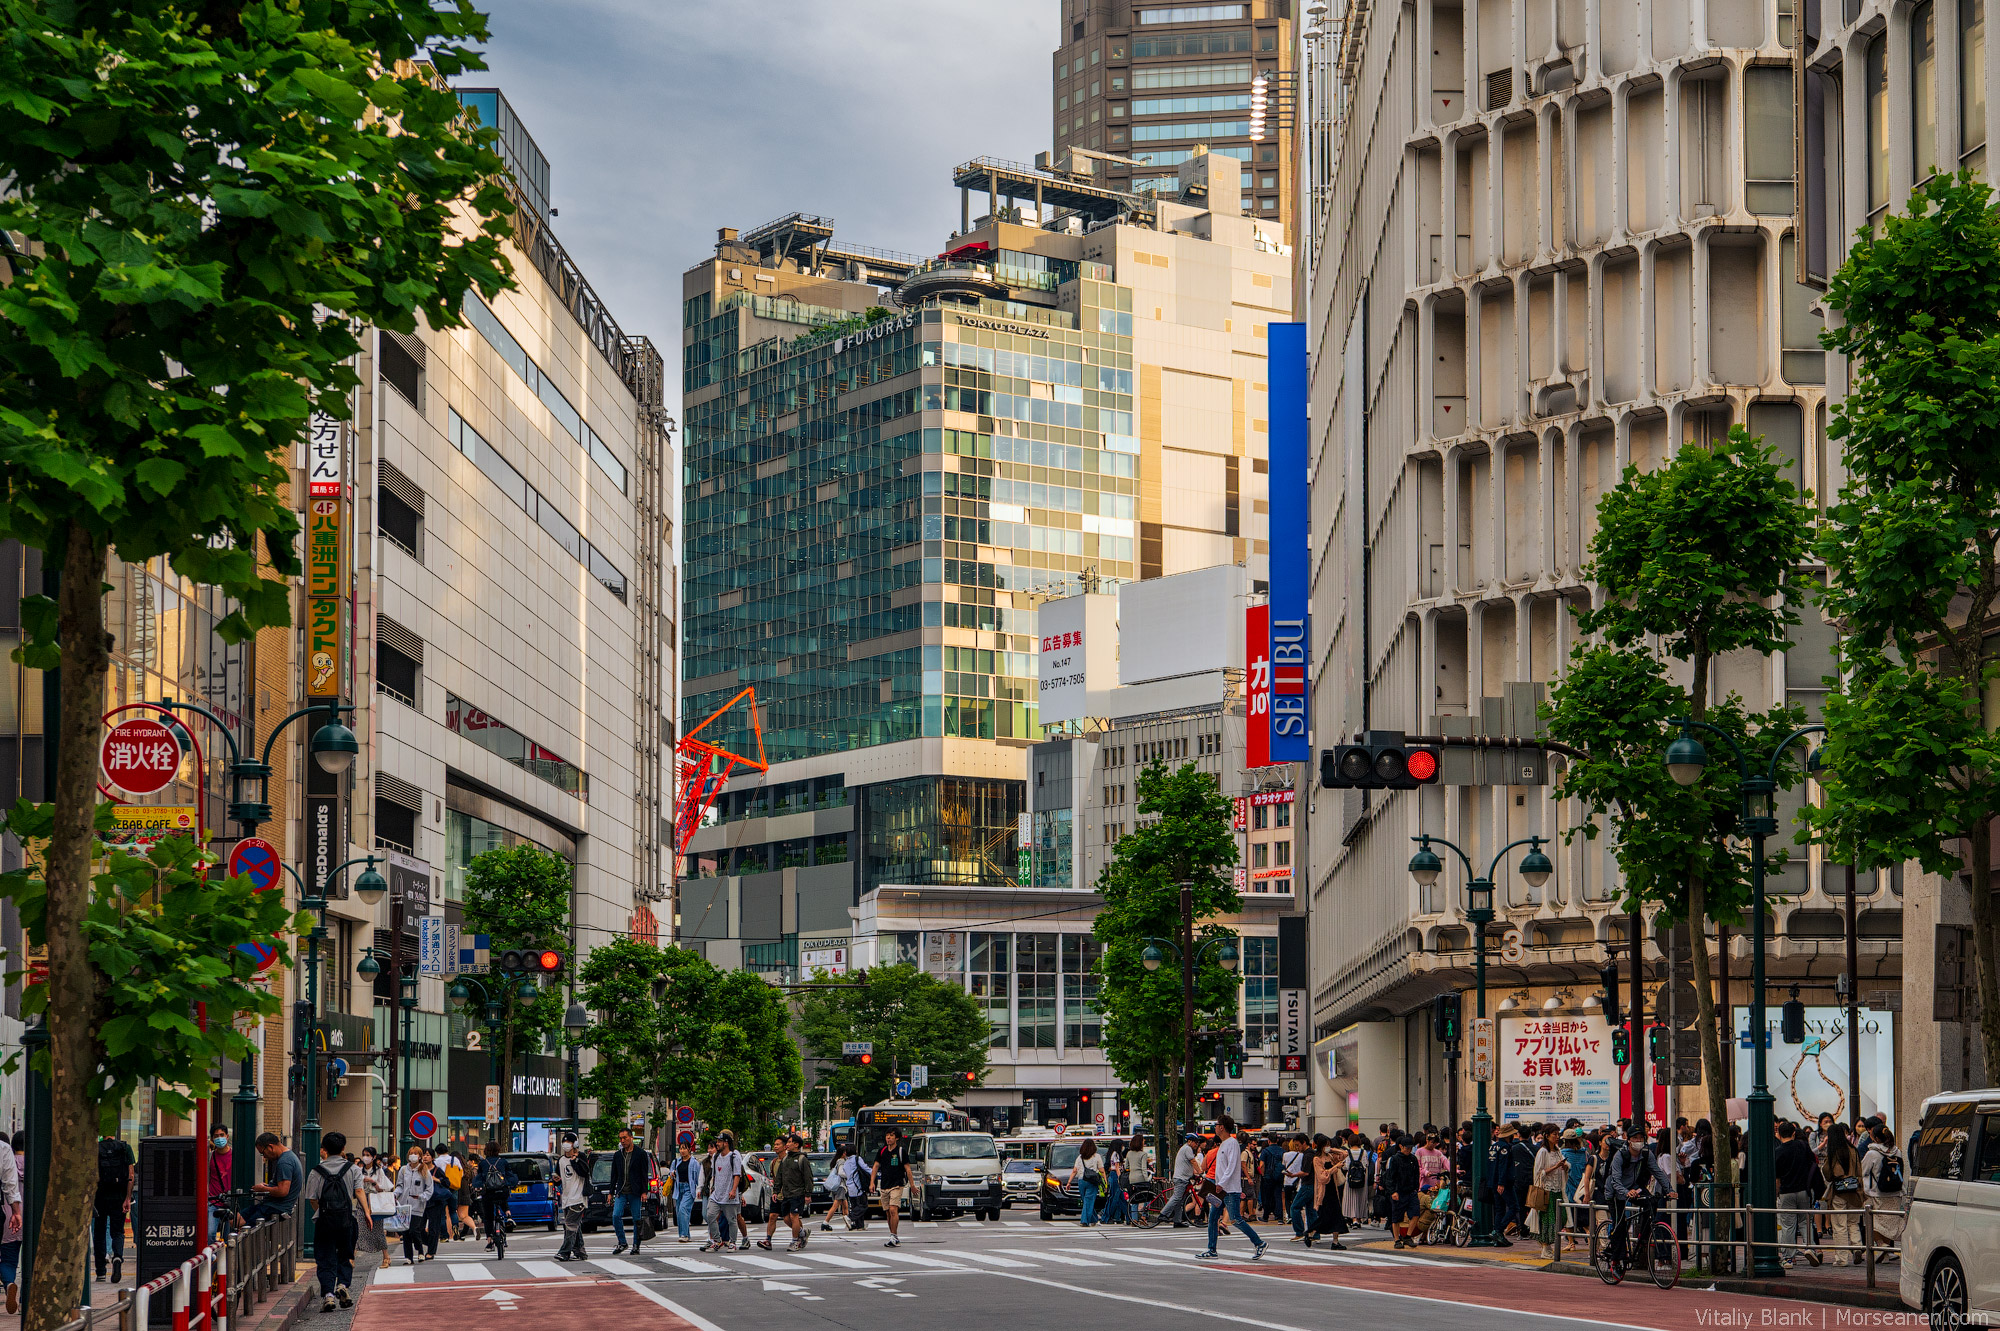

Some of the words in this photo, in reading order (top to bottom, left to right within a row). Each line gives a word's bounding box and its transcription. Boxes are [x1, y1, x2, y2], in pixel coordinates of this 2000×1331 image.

[847, 314, 913, 349] FUKURAS
[956, 315, 1004, 330] TOKYU
[1008, 323, 1051, 339] PLAZA
[316, 502, 333, 514] 4F
[312, 516, 338, 651] 八重洲コンタクト
[1042, 630, 1082, 653] 広告募集
[1052, 657, 1071, 669] No.147
[1040, 672, 1085, 691] 03-5774-7505
[1274, 618, 1305, 736] SEIBU
[115, 729, 131, 737] FIRE
[133, 729, 167, 737] HYDRANT
[109, 742, 174, 770] 消火栓
[1254, 793, 1282, 805] カラオケ
[145, 819, 171, 830] CAFE
[246, 840, 265, 848] 7-20
[316, 804, 329, 888] McDonald's
[431, 919, 440, 972] 井ノ頭通り入口
[802, 940, 823, 949] TOKYU
[825, 938, 847, 947] PLAZA
[1501, 929, 1524, 963] 3
[460, 964, 489, 973] 時差式
[1287, 990, 1299, 1054] TSUTAYA
[1523, 1021, 1588, 1035] ご入会当日から
[1830, 1018, 1845, 1034] &
[467, 1031, 482, 1051] 2
[1477, 1023, 1487, 1077] 公園通り
[1514, 1036, 1600, 1056] アプリ払いで
[1287, 1057, 1299, 1069] 本
[1522, 1057, 1592, 1077] お買い物。
[546, 1078, 561, 1097] EAGLE
[1504, 1099, 1536, 1107] 新会員募集中
[145, 1225, 196, 1237] 公園通り
